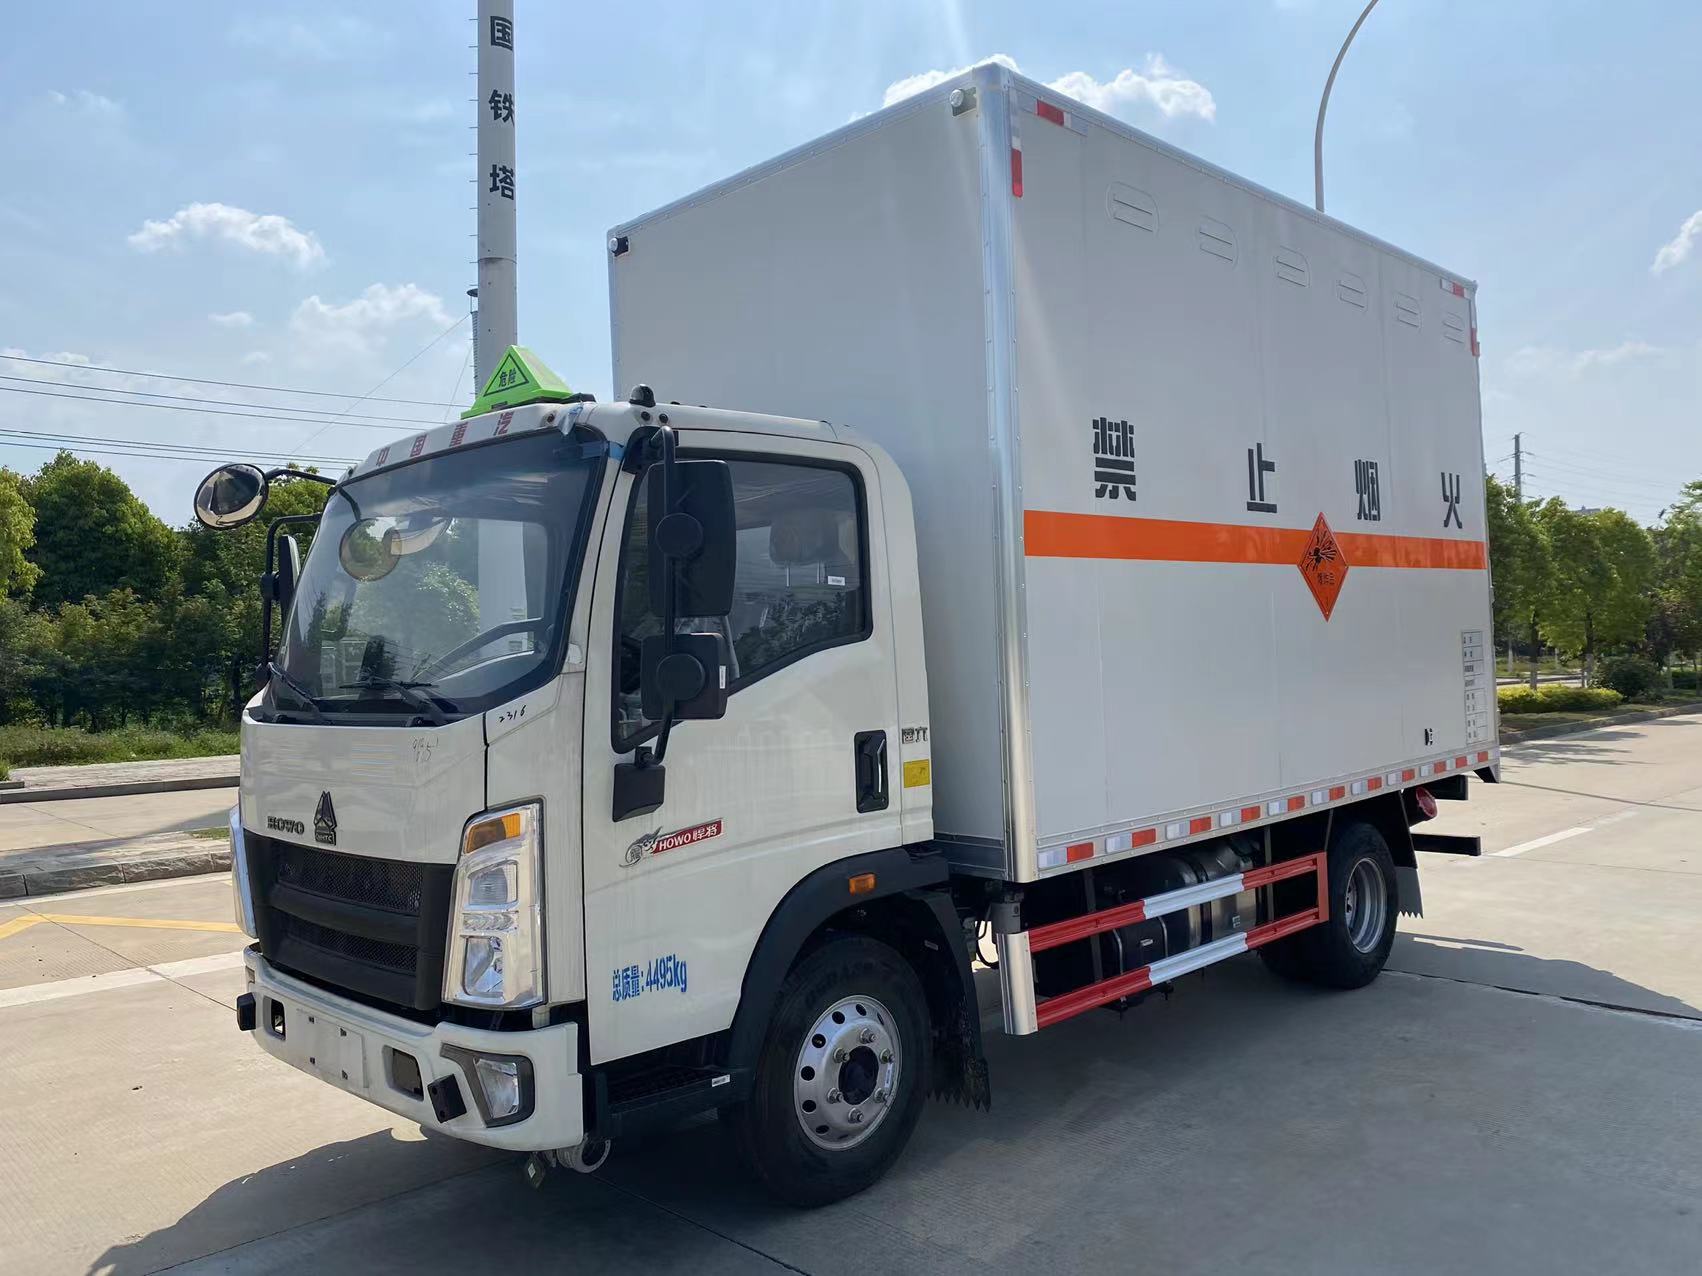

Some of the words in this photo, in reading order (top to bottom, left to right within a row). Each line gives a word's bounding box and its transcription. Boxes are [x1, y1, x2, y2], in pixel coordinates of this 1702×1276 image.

[489, 15, 515, 201] 国铁塔
[1092, 416, 1463, 530] 禁止烟火
[659, 833, 691, 851] HOWO
